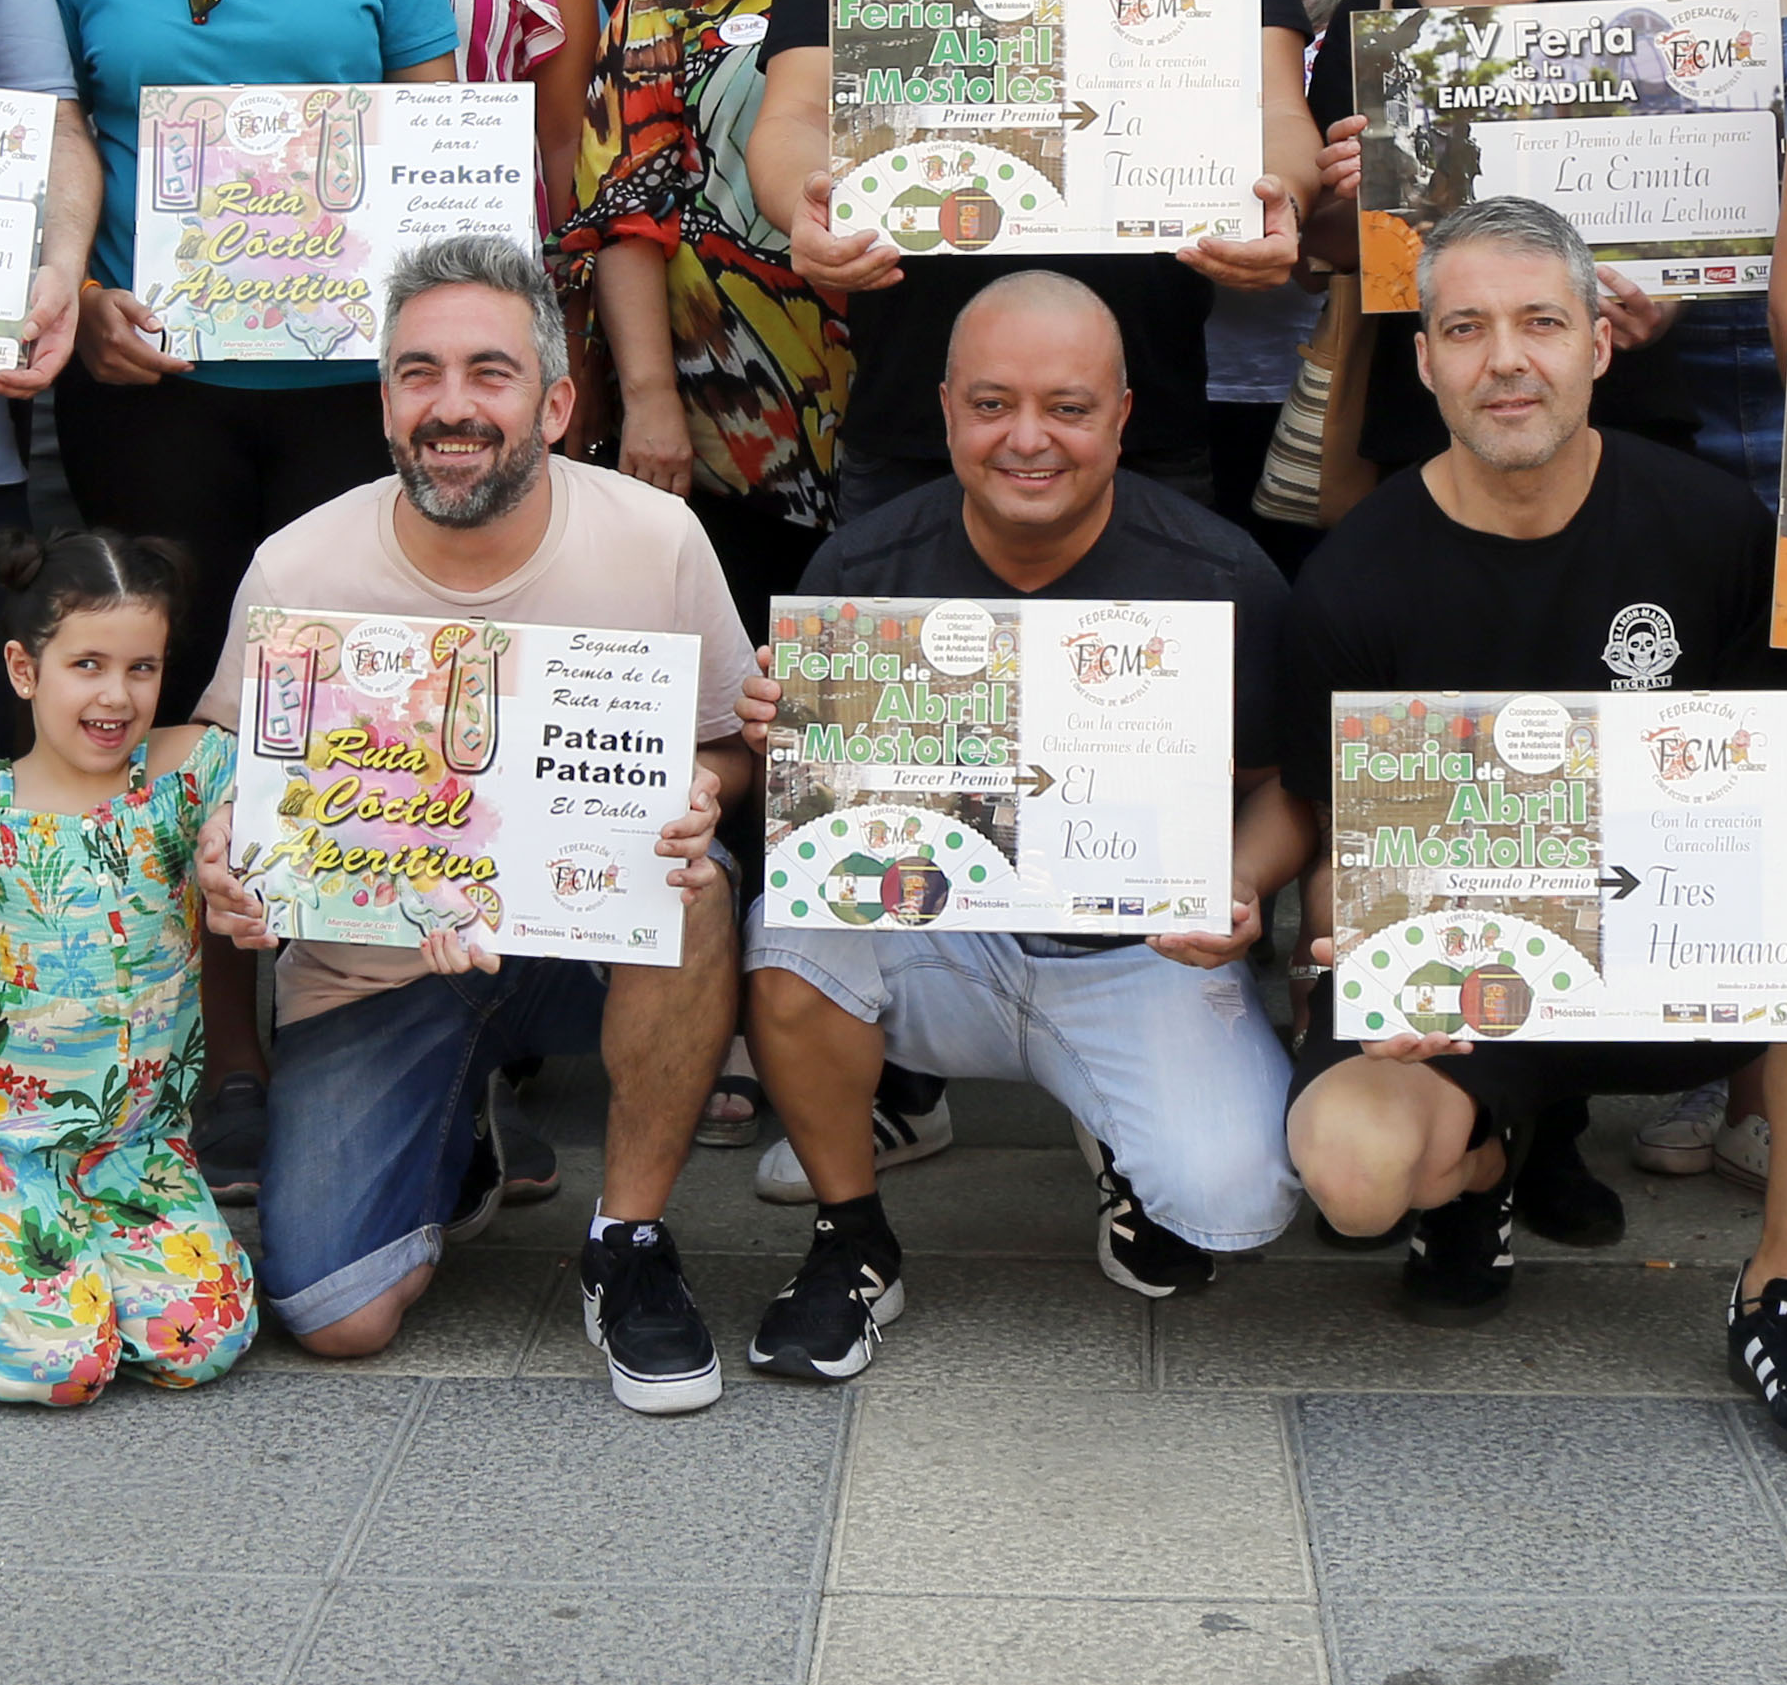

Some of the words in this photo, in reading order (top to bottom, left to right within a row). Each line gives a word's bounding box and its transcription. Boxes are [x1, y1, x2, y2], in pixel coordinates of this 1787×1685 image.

[955, 10, 981, 28] de
[930, 27, 1052, 66] Abril
[1463, 22, 1500, 60] V
[1514, 17, 1634, 58] Feria
[1109, 53, 1134, 69] Con
[1139, 54, 1152, 68] la
[1155, 53, 1207, 68] creación
[1510, 63, 1536, 79] de
[1543, 61, 1563, 78] la
[396, 90, 453, 106] Primer
[460, 91, 519, 106] Premio
[835, 90, 861, 106] en
[866, 68, 1055, 104] Móstoles
[1438, 80, 1638, 109] EMPANADILLA
[409, 113, 432, 127] de
[437, 113, 454, 127] la
[459, 113, 502, 128] Ruta
[943, 108, 996, 123] Primer
[1000, 108, 1055, 123] Premio
[1103, 100, 1142, 139] La
[432, 138, 479, 153] para:
[1513, 132, 1560, 151] Tercer
[1565, 132, 1622, 149] Premio
[1625, 132, 1643, 146] de
[1648, 131, 1662, 145] la
[1665, 129, 1708, 147] Feria
[1711, 132, 1751, 148] para:
[391, 165, 521, 185] Freakafe
[1105, 150, 1236, 195] Tasquita
[1555, 156, 1593, 192] La
[1607, 156, 1711, 190] Ermita
[215, 182, 306, 215] Ruta
[407, 195, 478, 212] Cocktail
[484, 195, 503, 210] de
[1661, 198, 1747, 224] Lechona
[207, 222, 343, 262] Cóctel
[167, 270, 370, 307] Aperitivo
[569, 634, 650, 655] Segundo
[545, 660, 614, 682] Premio
[622, 669, 644, 684] de
[651, 669, 671, 684] la
[775, 643, 901, 681] Feria
[902, 662, 930, 682] de
[551, 690, 601, 711] Ruta
[607, 697, 661, 714] para:
[875, 682, 1006, 723] Abril
[1067, 714, 1094, 732] Con
[1099, 715, 1114, 731] la
[1117, 714, 1173, 732] creación
[326, 730, 427, 769] Ruta
[543, 724, 665, 755] Patatín
[771, 745, 800, 762] en
[803, 724, 1009, 763] Móstoles
[536, 758, 667, 787] Patatón
[1342, 740, 1472, 781] Feria
[1476, 762, 1505, 781] de
[893, 771, 945, 788] Tercer
[949, 771, 1009, 788] Premio
[1061, 766, 1095, 805] El
[315, 777, 473, 826] Cóctel
[550, 797, 577, 815] El
[585, 799, 648, 820] Diablo
[1446, 782, 1587, 824] Abril
[1650, 811, 1680, 829] Con
[1685, 812, 1701, 828] la
[1704, 811, 1762, 829] creación
[262, 828, 497, 881] Aperitivo
[1061, 819, 1138, 860] Roto
[1340, 849, 1370, 868] en
[1374, 825, 1590, 867] Móstoles
[1663, 834, 1751, 853] Caracolillos
[1446, 874, 1524, 894] Segundo
[1529, 874, 1590, 890] Premio
[1647, 865, 1716, 907] Tres
